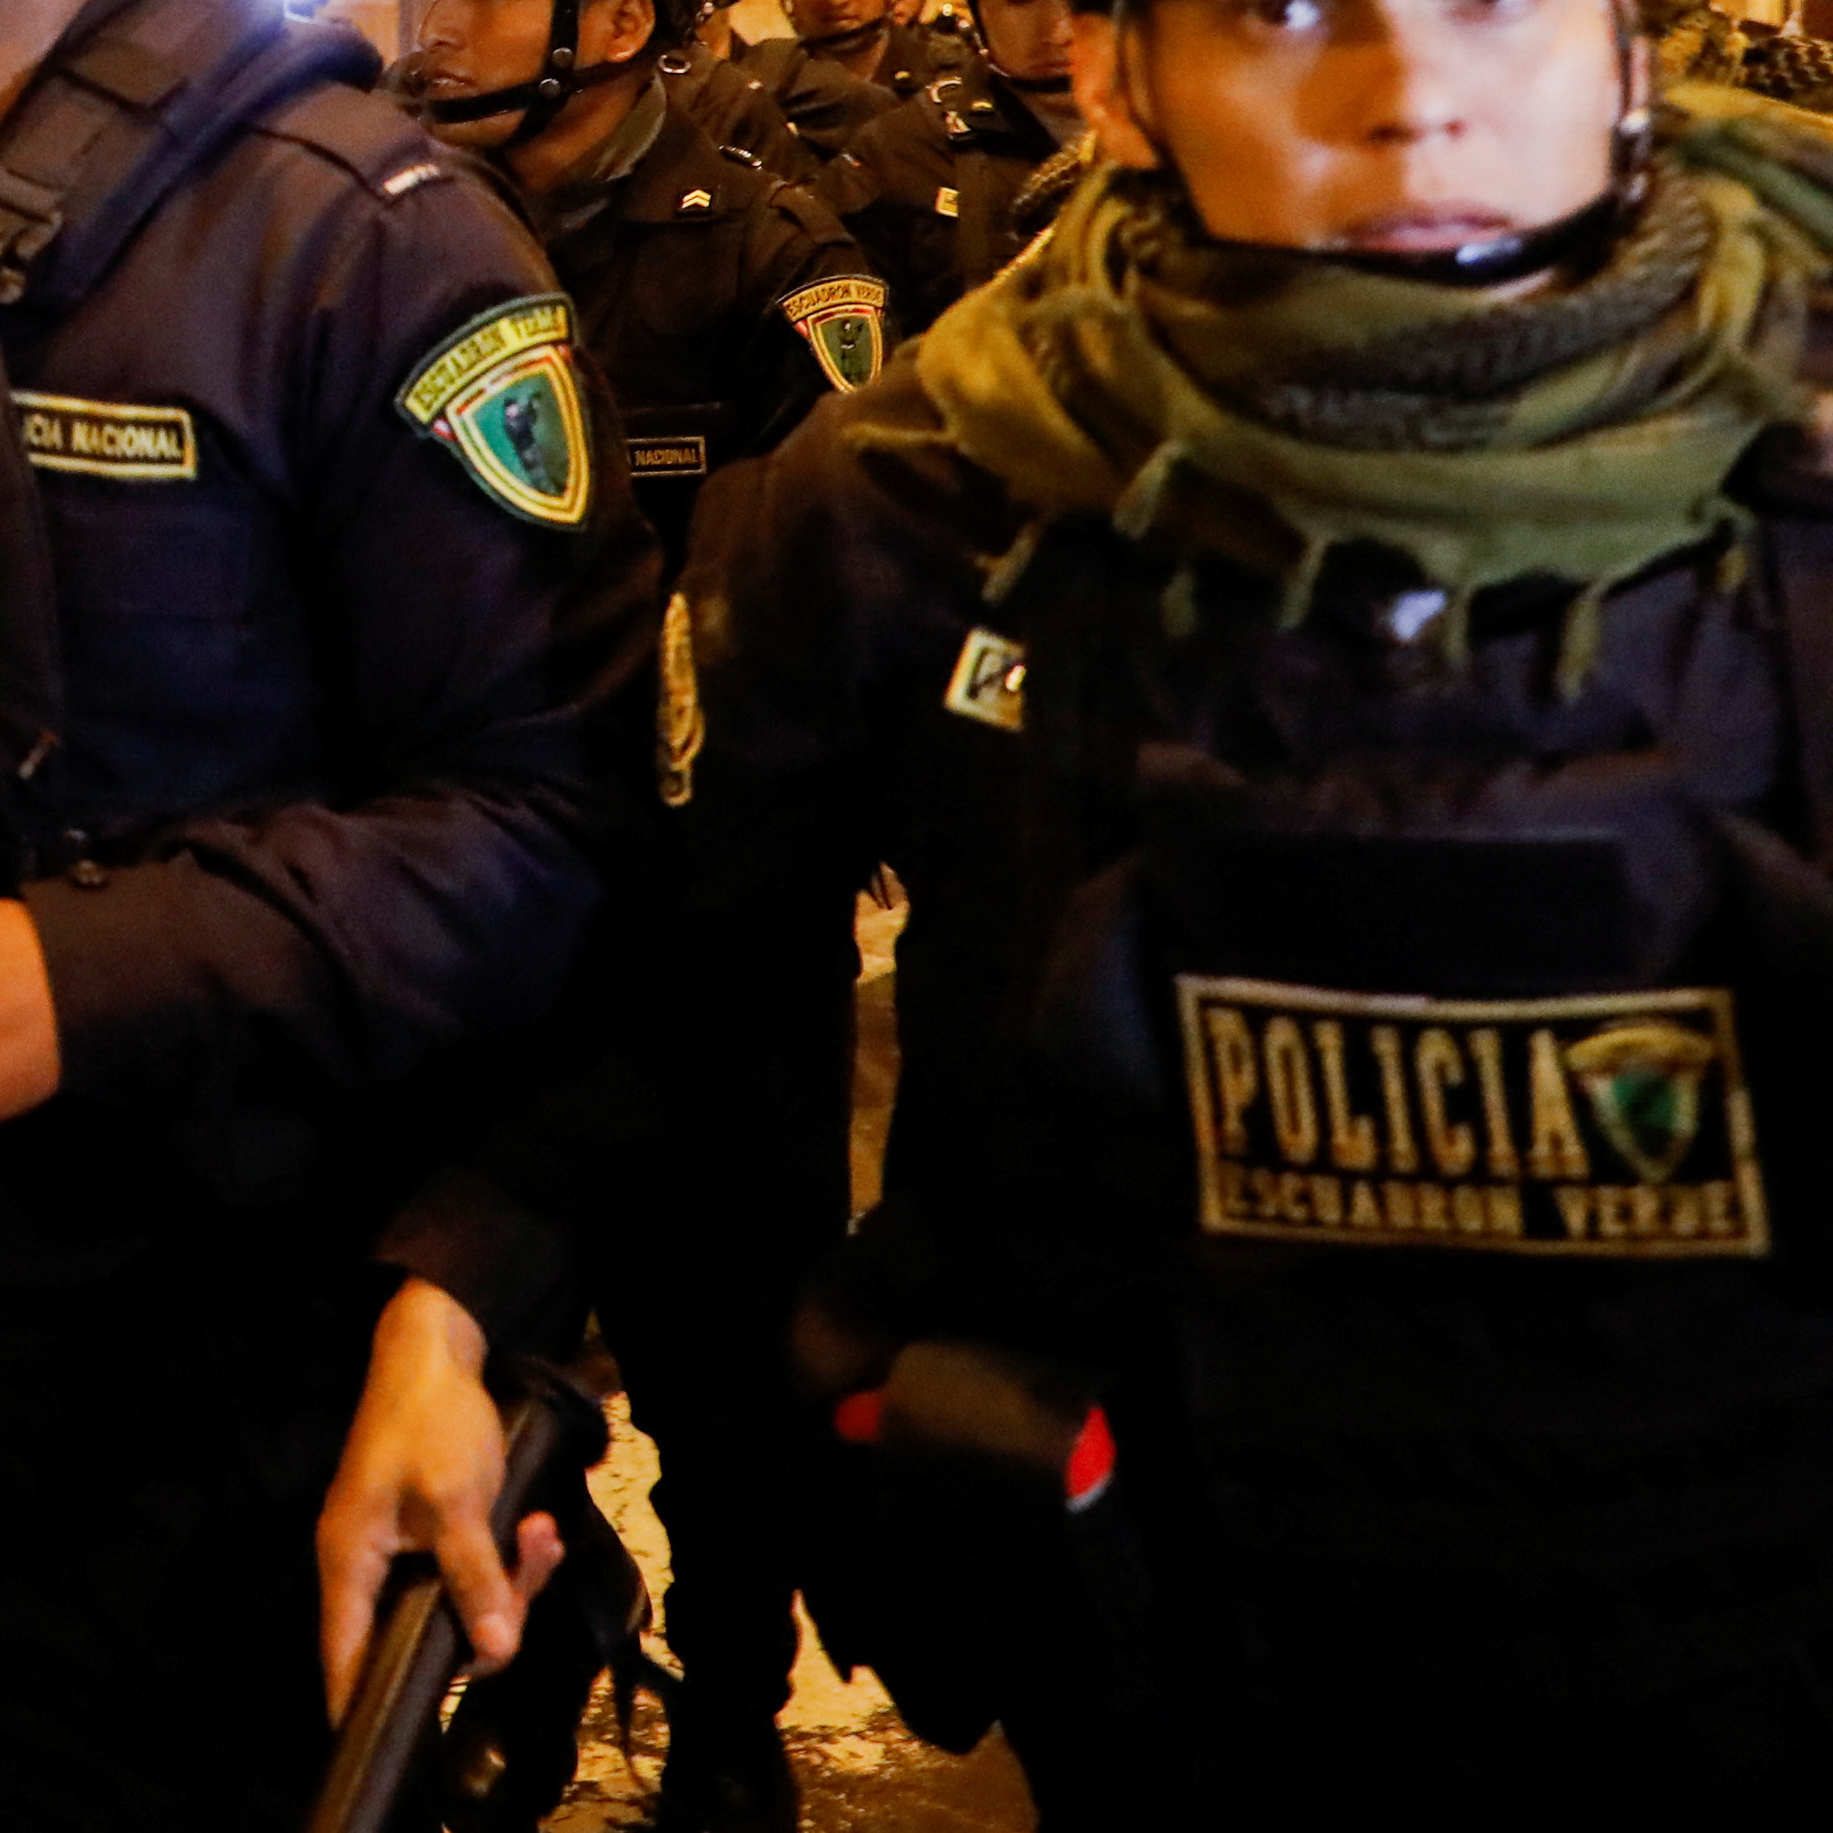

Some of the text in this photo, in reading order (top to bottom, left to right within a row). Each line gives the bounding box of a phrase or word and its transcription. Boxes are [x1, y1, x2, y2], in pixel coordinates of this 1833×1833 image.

[72, 419, 184, 460] NACIONAL
[634, 448, 699, 466] NACIONAL
[1205, 1006, 1589, 1179] POLICIA
